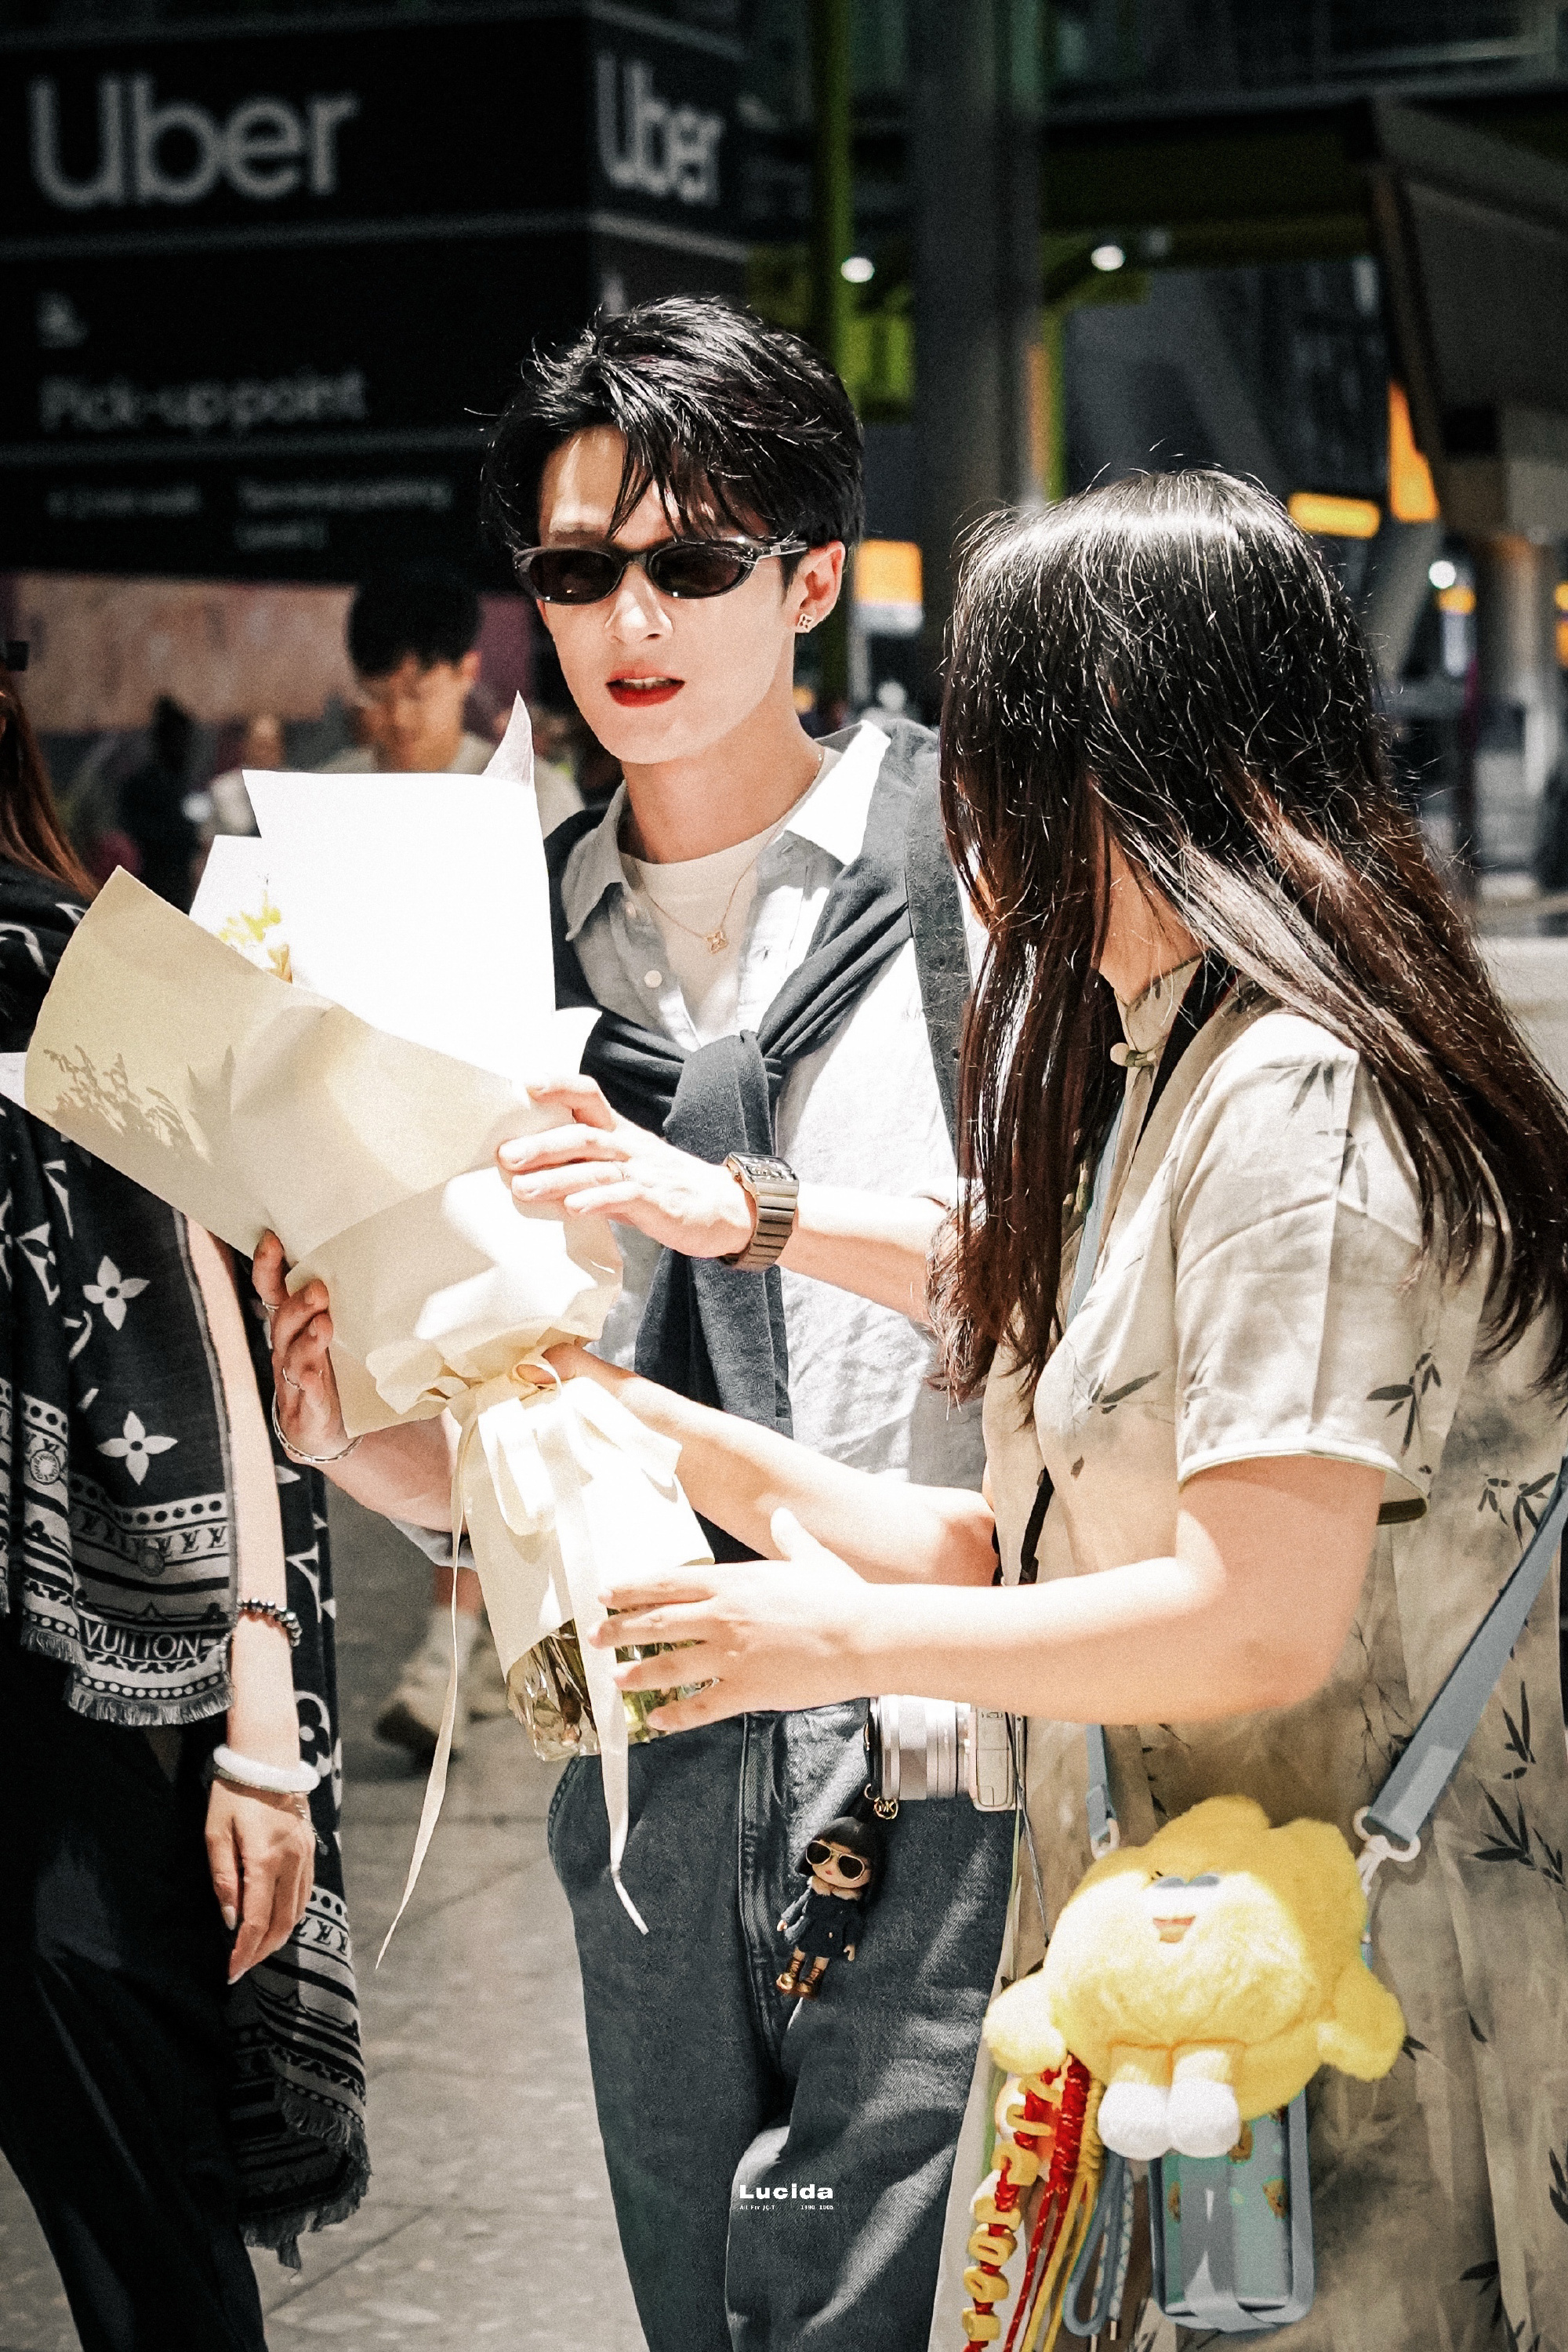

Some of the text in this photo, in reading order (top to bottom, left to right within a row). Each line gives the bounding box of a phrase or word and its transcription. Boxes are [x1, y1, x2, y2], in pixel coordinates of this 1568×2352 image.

[29, 73, 361, 209] Uber
[595, 52, 724, 205] Uber
[84, 1619, 201, 1660] VUITTON
